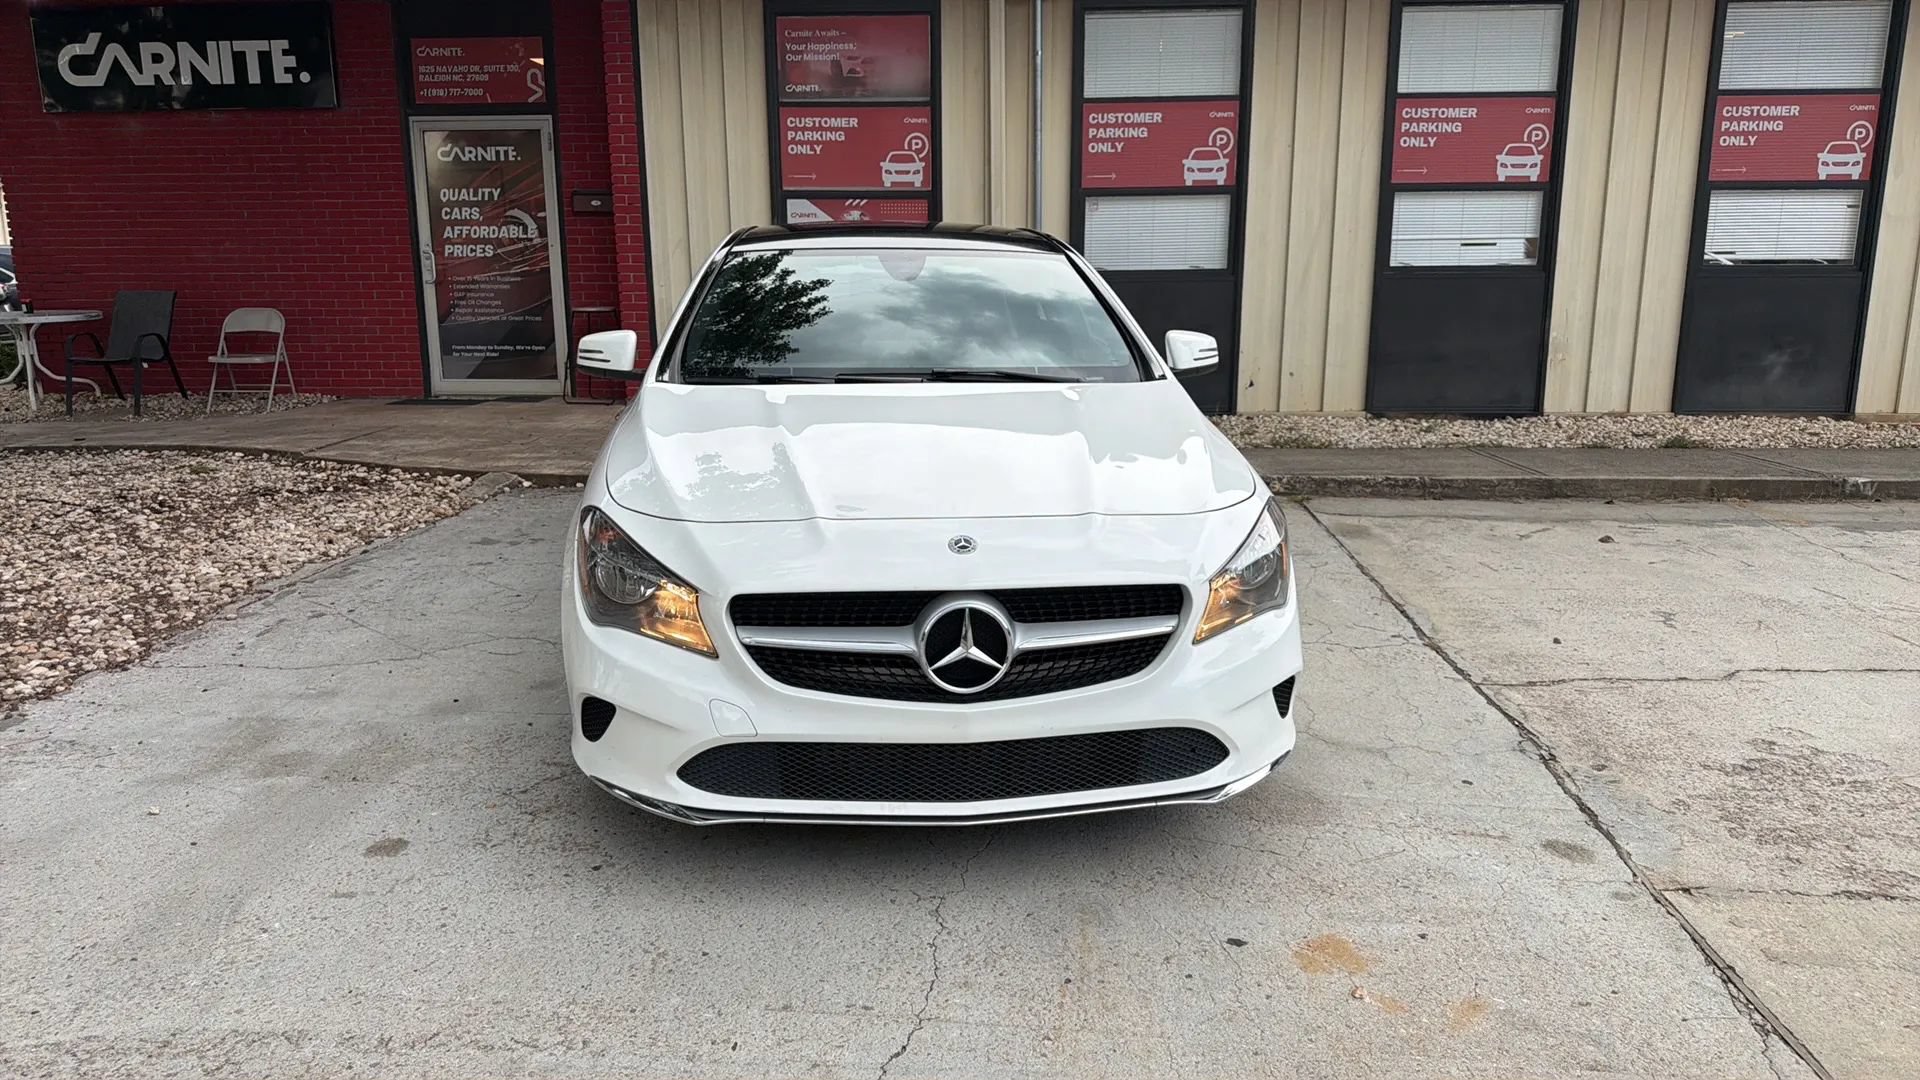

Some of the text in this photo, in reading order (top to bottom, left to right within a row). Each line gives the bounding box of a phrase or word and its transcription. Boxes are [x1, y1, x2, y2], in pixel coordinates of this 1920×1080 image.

[814, 29, 840, 37] Awaits
[416, 46, 465, 56] CARNITE.
[785, 42, 806, 51] Your
[57, 32, 311, 87] CARNITE.
[785, 52, 840, 62] Our Mission!
[436, 65, 468, 73] NAVAHO
[483, 64, 505, 72] SUITE
[418, 74, 452, 82] RALEIGH
[449, 88, 484, 96] 717-7000
[1402, 108, 1478, 118] CUSTOMER
[1722, 106, 1800, 117] CUSTOMER
[787, 117, 858, 128] CUSTOMER
[1088, 112, 1162, 124] CUSTOMER
[1401, 122, 1462, 133] PARKING
[1720, 120, 1784, 132] PARKING
[788, 131, 846, 142] PARKING
[1088, 128, 1148, 138] PARKING
[1532, 130, 1544, 142] P
[1854, 128, 1866, 140] P
[912, 140, 922, 150] P
[1216, 134, 1228, 147] P
[1400, 137, 1438, 148] ONLY
[1719, 136, 1758, 146] ONLY
[437, 143, 522, 162] CARNITE.
[788, 144, 822, 155] ONLY
[1088, 142, 1124, 153] ONLY
[440, 188, 501, 203] QUALITY
[442, 207, 483, 222] CARS,
[443, 226, 538, 239] AFFORDABLE
[444, 244, 494, 257] PRICES
